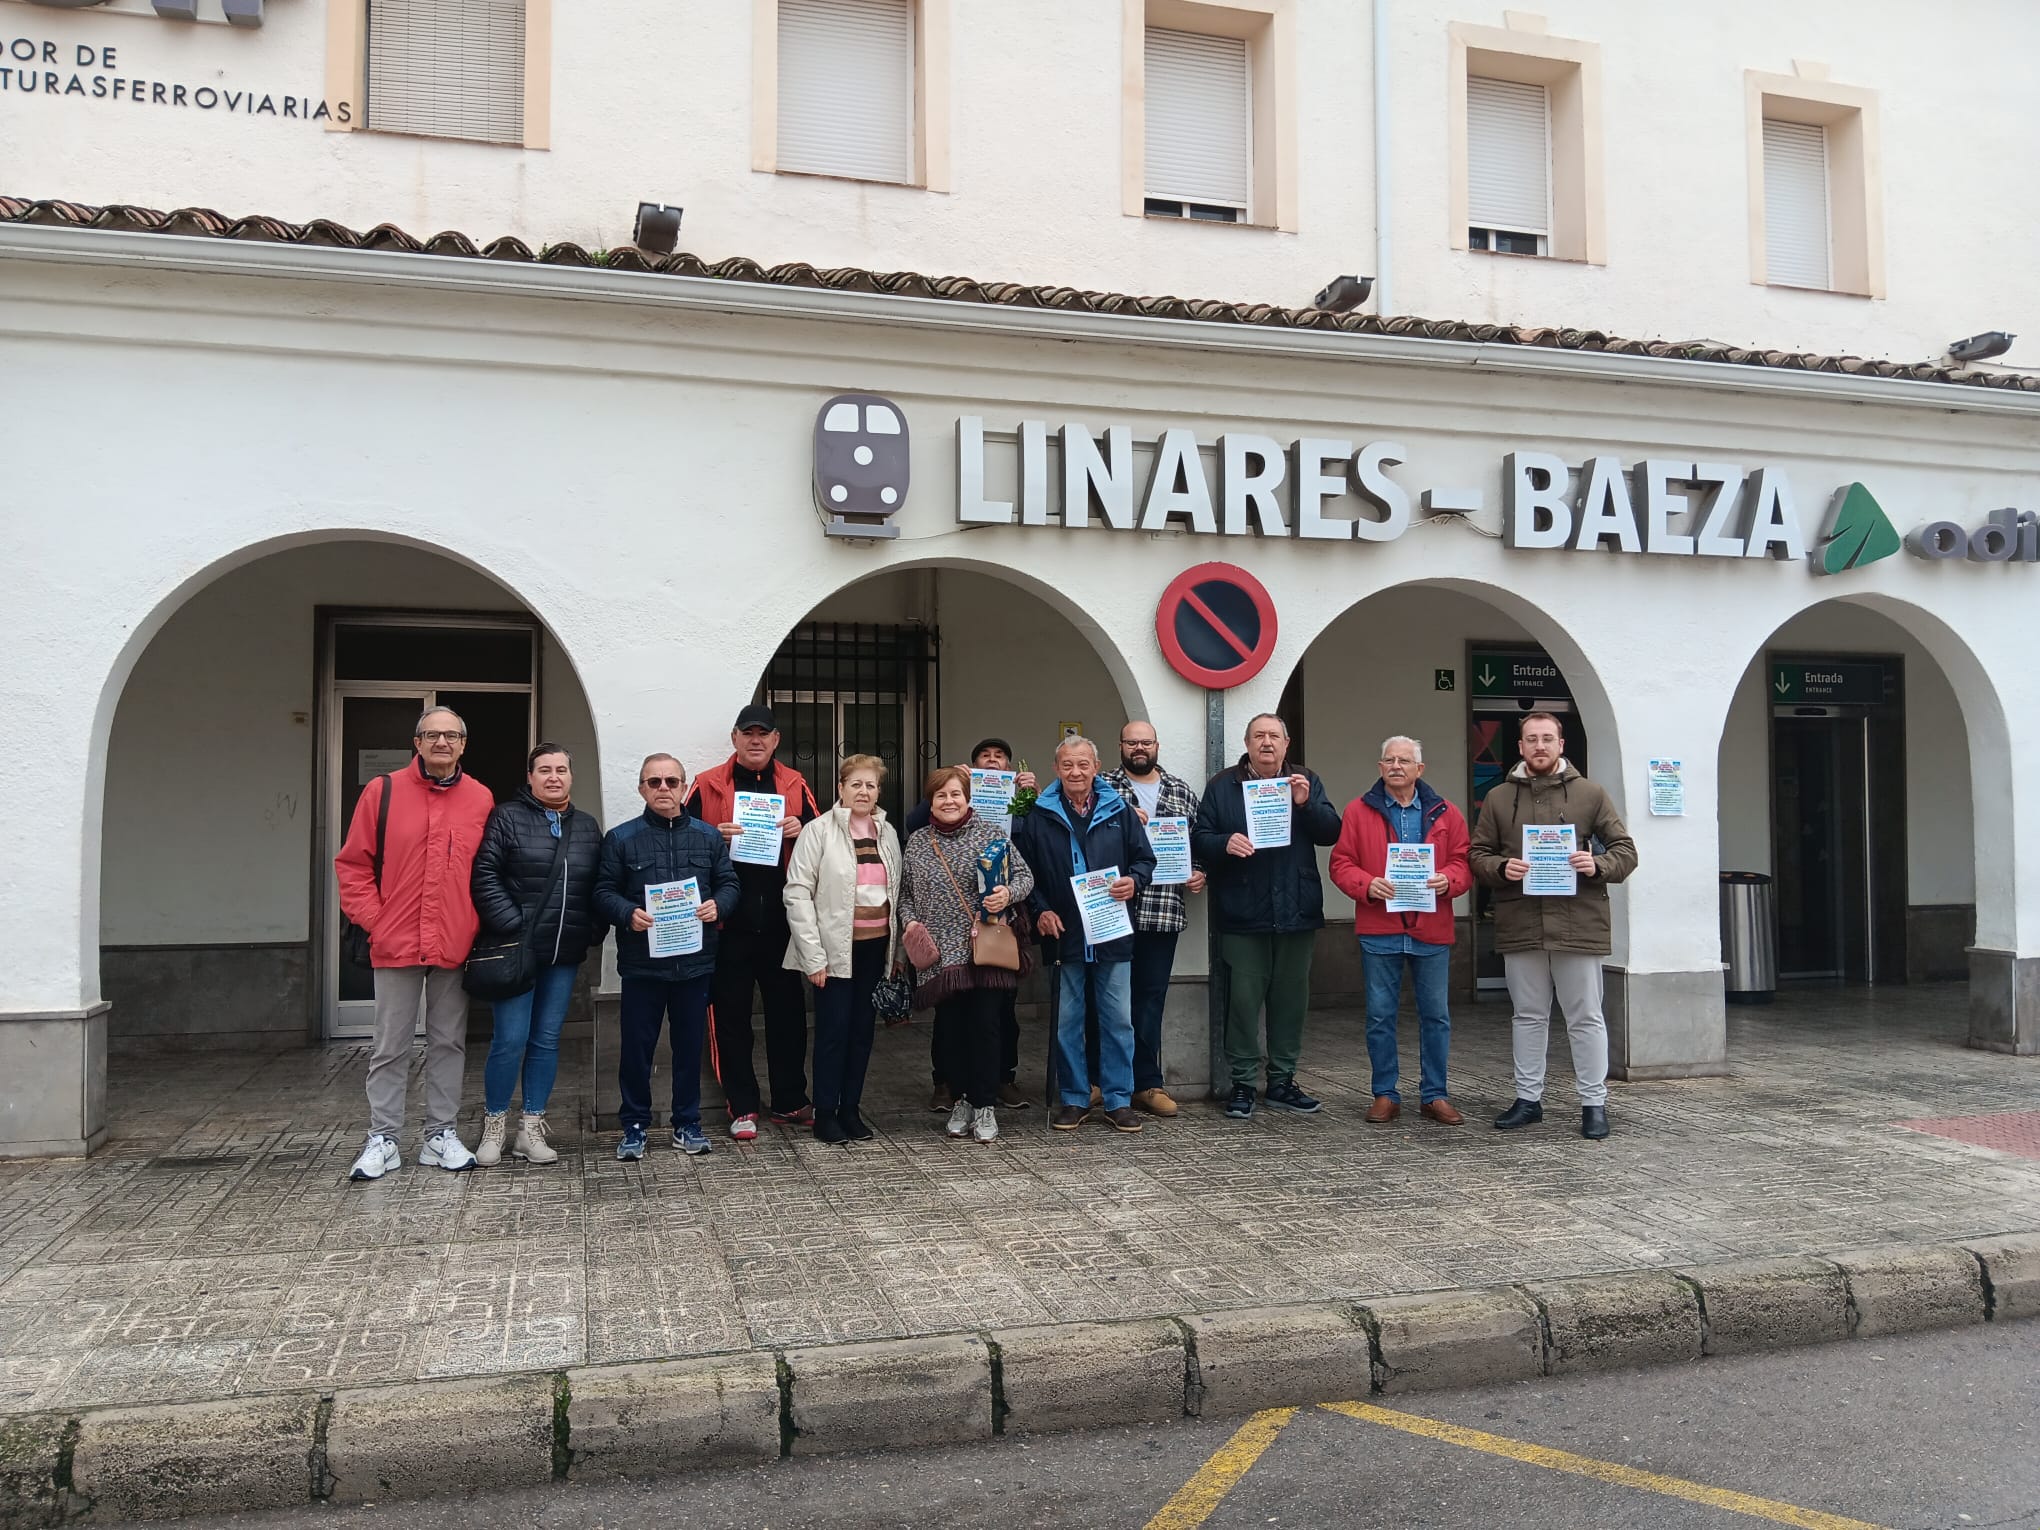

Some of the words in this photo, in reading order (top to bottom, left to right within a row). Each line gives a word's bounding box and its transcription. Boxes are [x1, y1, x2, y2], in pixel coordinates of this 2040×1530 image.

[0, 38, 57, 64] OR
[76, 44, 117, 69] DE
[955, 415, 1410, 543] LINARES
[1502, 451, 1806, 562] BAEZA
[1512, 664, 1556, 677] Entrada
[1805, 672, 1844, 684] Entrada
